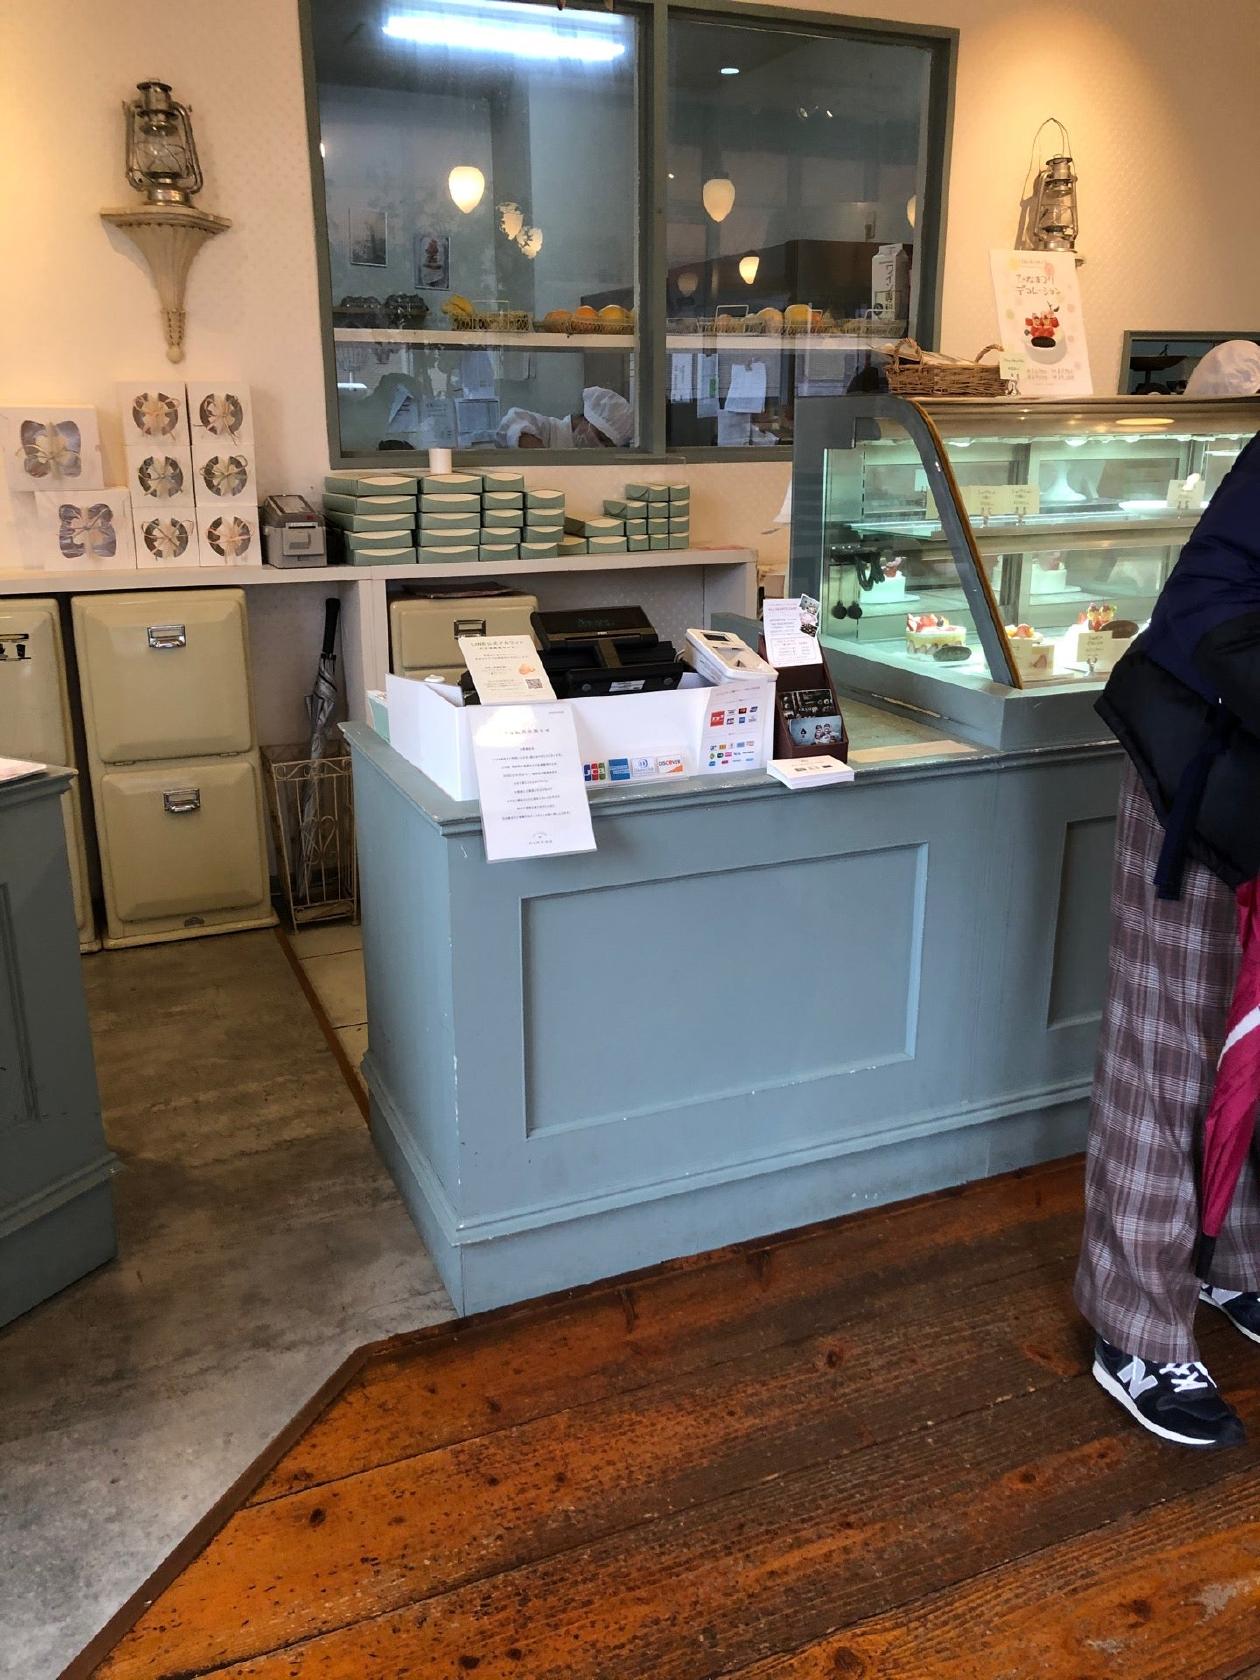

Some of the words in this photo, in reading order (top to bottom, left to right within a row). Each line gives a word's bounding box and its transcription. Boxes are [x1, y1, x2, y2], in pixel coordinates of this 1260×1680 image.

[1016, 285, 1062, 296] デコレーション
[583, 764, 606, 781] JCB
[1117, 1355, 1159, 1400] N
